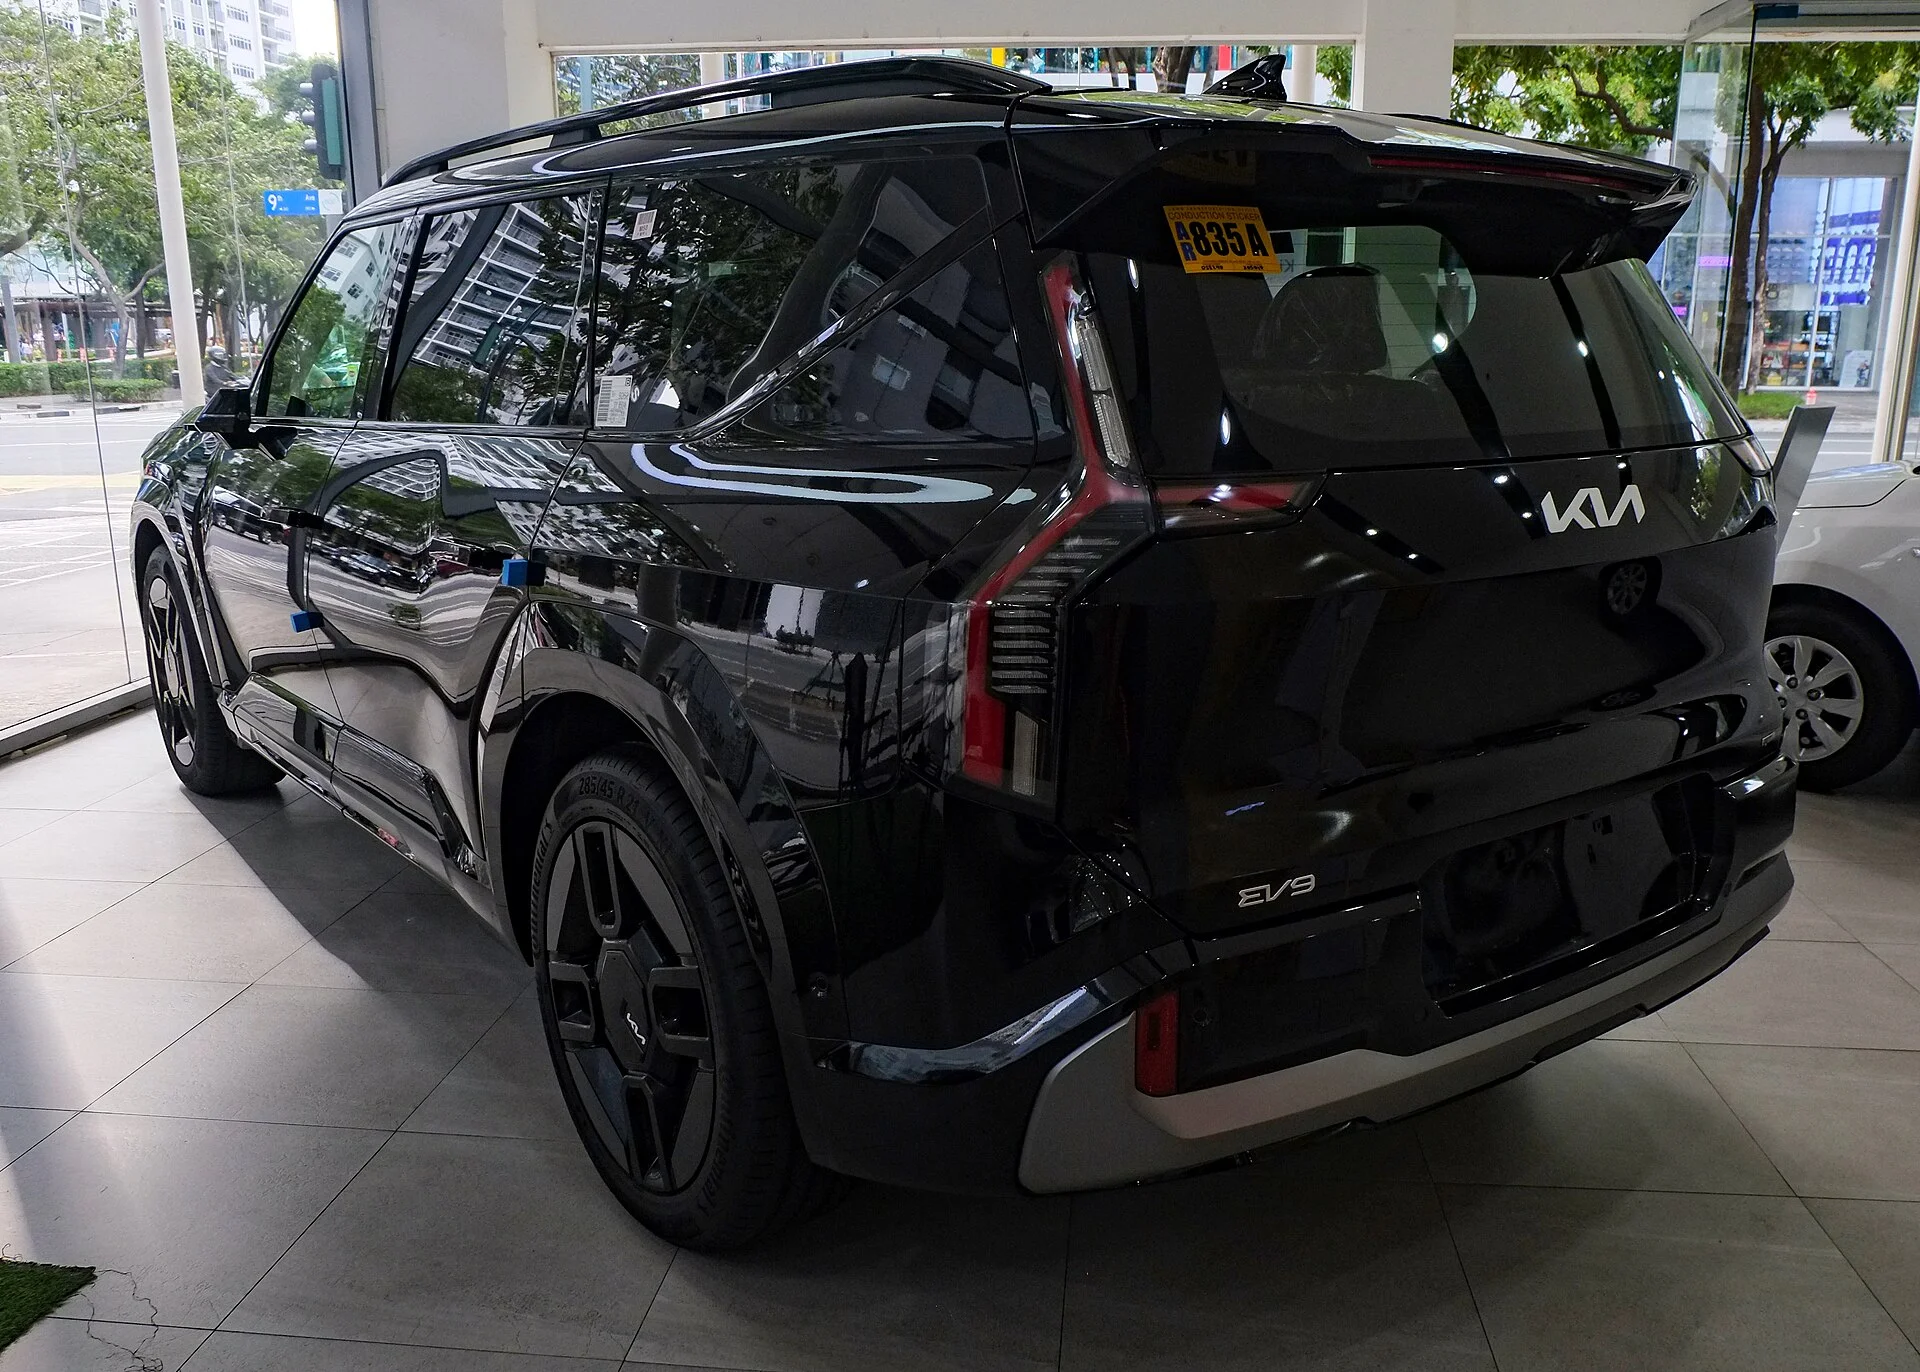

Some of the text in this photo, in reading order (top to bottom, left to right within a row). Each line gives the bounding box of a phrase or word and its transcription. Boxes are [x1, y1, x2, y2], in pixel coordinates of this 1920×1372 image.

[1168, 211, 1260, 220] CONDUCTION STICKER
[1189, 221, 1269, 256] 835 A
[1540, 484, 1646, 534] KIA
[578, 775, 614, 799] 285/45
[616, 785, 625, 805] R
[1238, 874, 1316, 908] EV9
